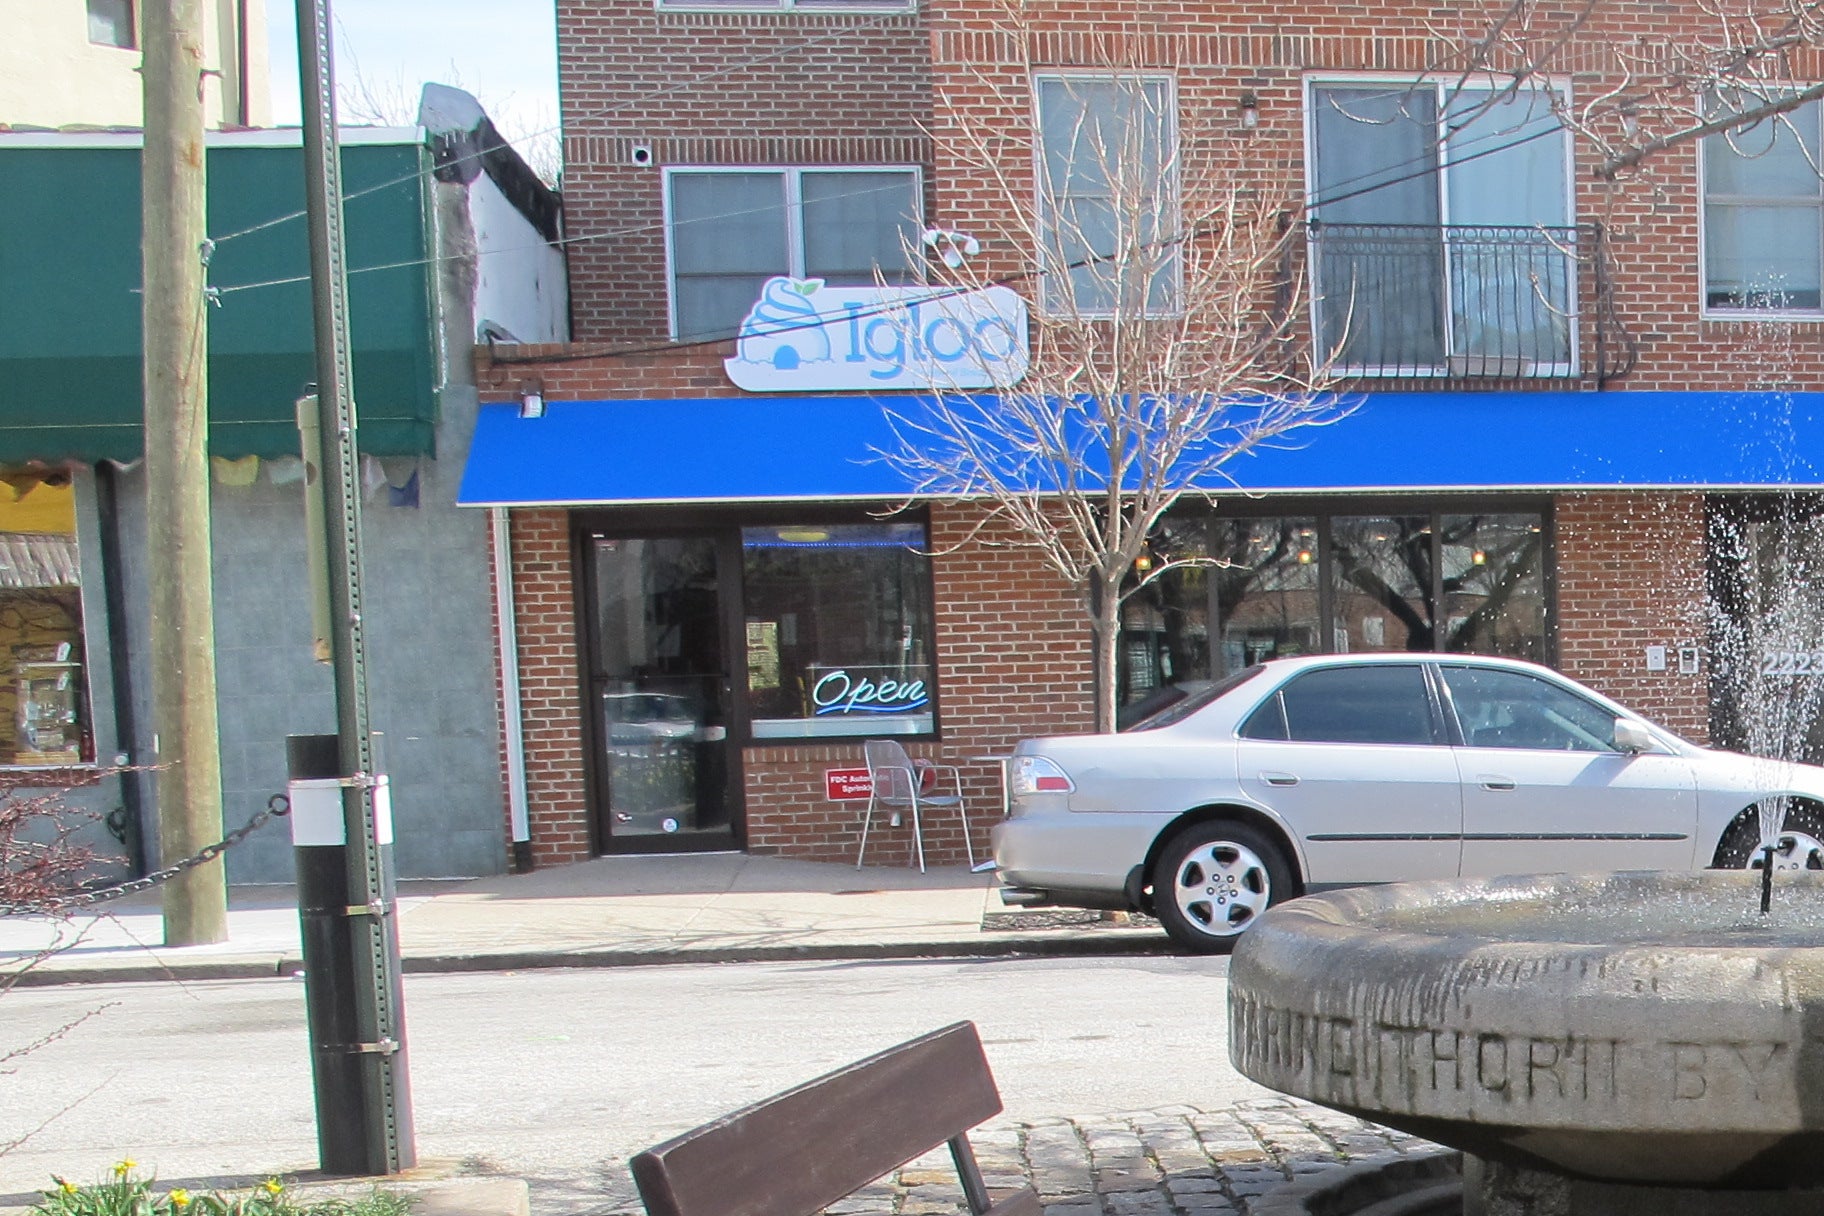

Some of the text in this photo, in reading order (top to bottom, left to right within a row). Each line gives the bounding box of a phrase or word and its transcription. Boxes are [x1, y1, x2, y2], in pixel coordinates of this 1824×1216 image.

[843, 301, 1019, 380] Igloo
[813, 670, 926, 713] Open
[1668, 1040, 1790, 1101] BY
